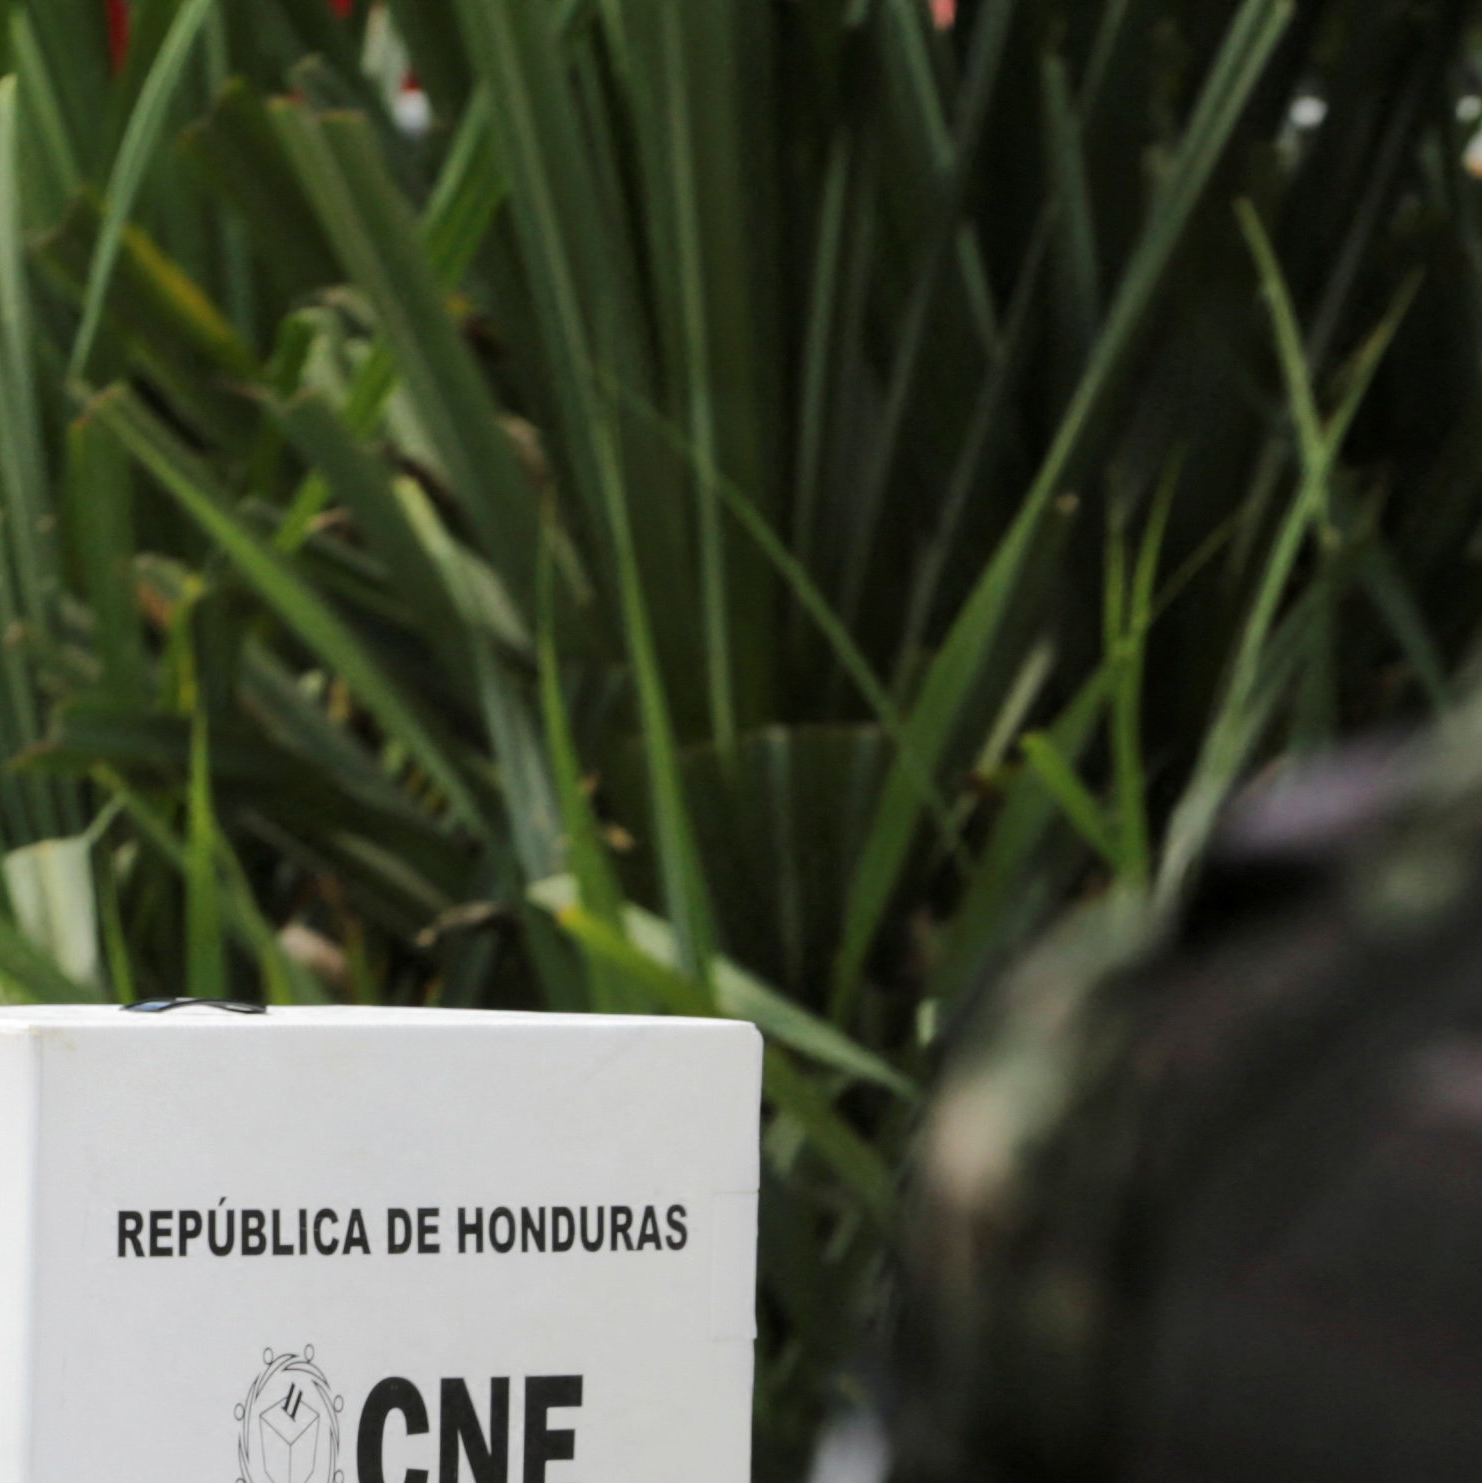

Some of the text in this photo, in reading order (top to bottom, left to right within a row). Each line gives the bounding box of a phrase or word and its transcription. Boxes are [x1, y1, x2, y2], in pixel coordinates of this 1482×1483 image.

[117, 1196, 688, 1258] REPÚBLICA DE HONDURAS
